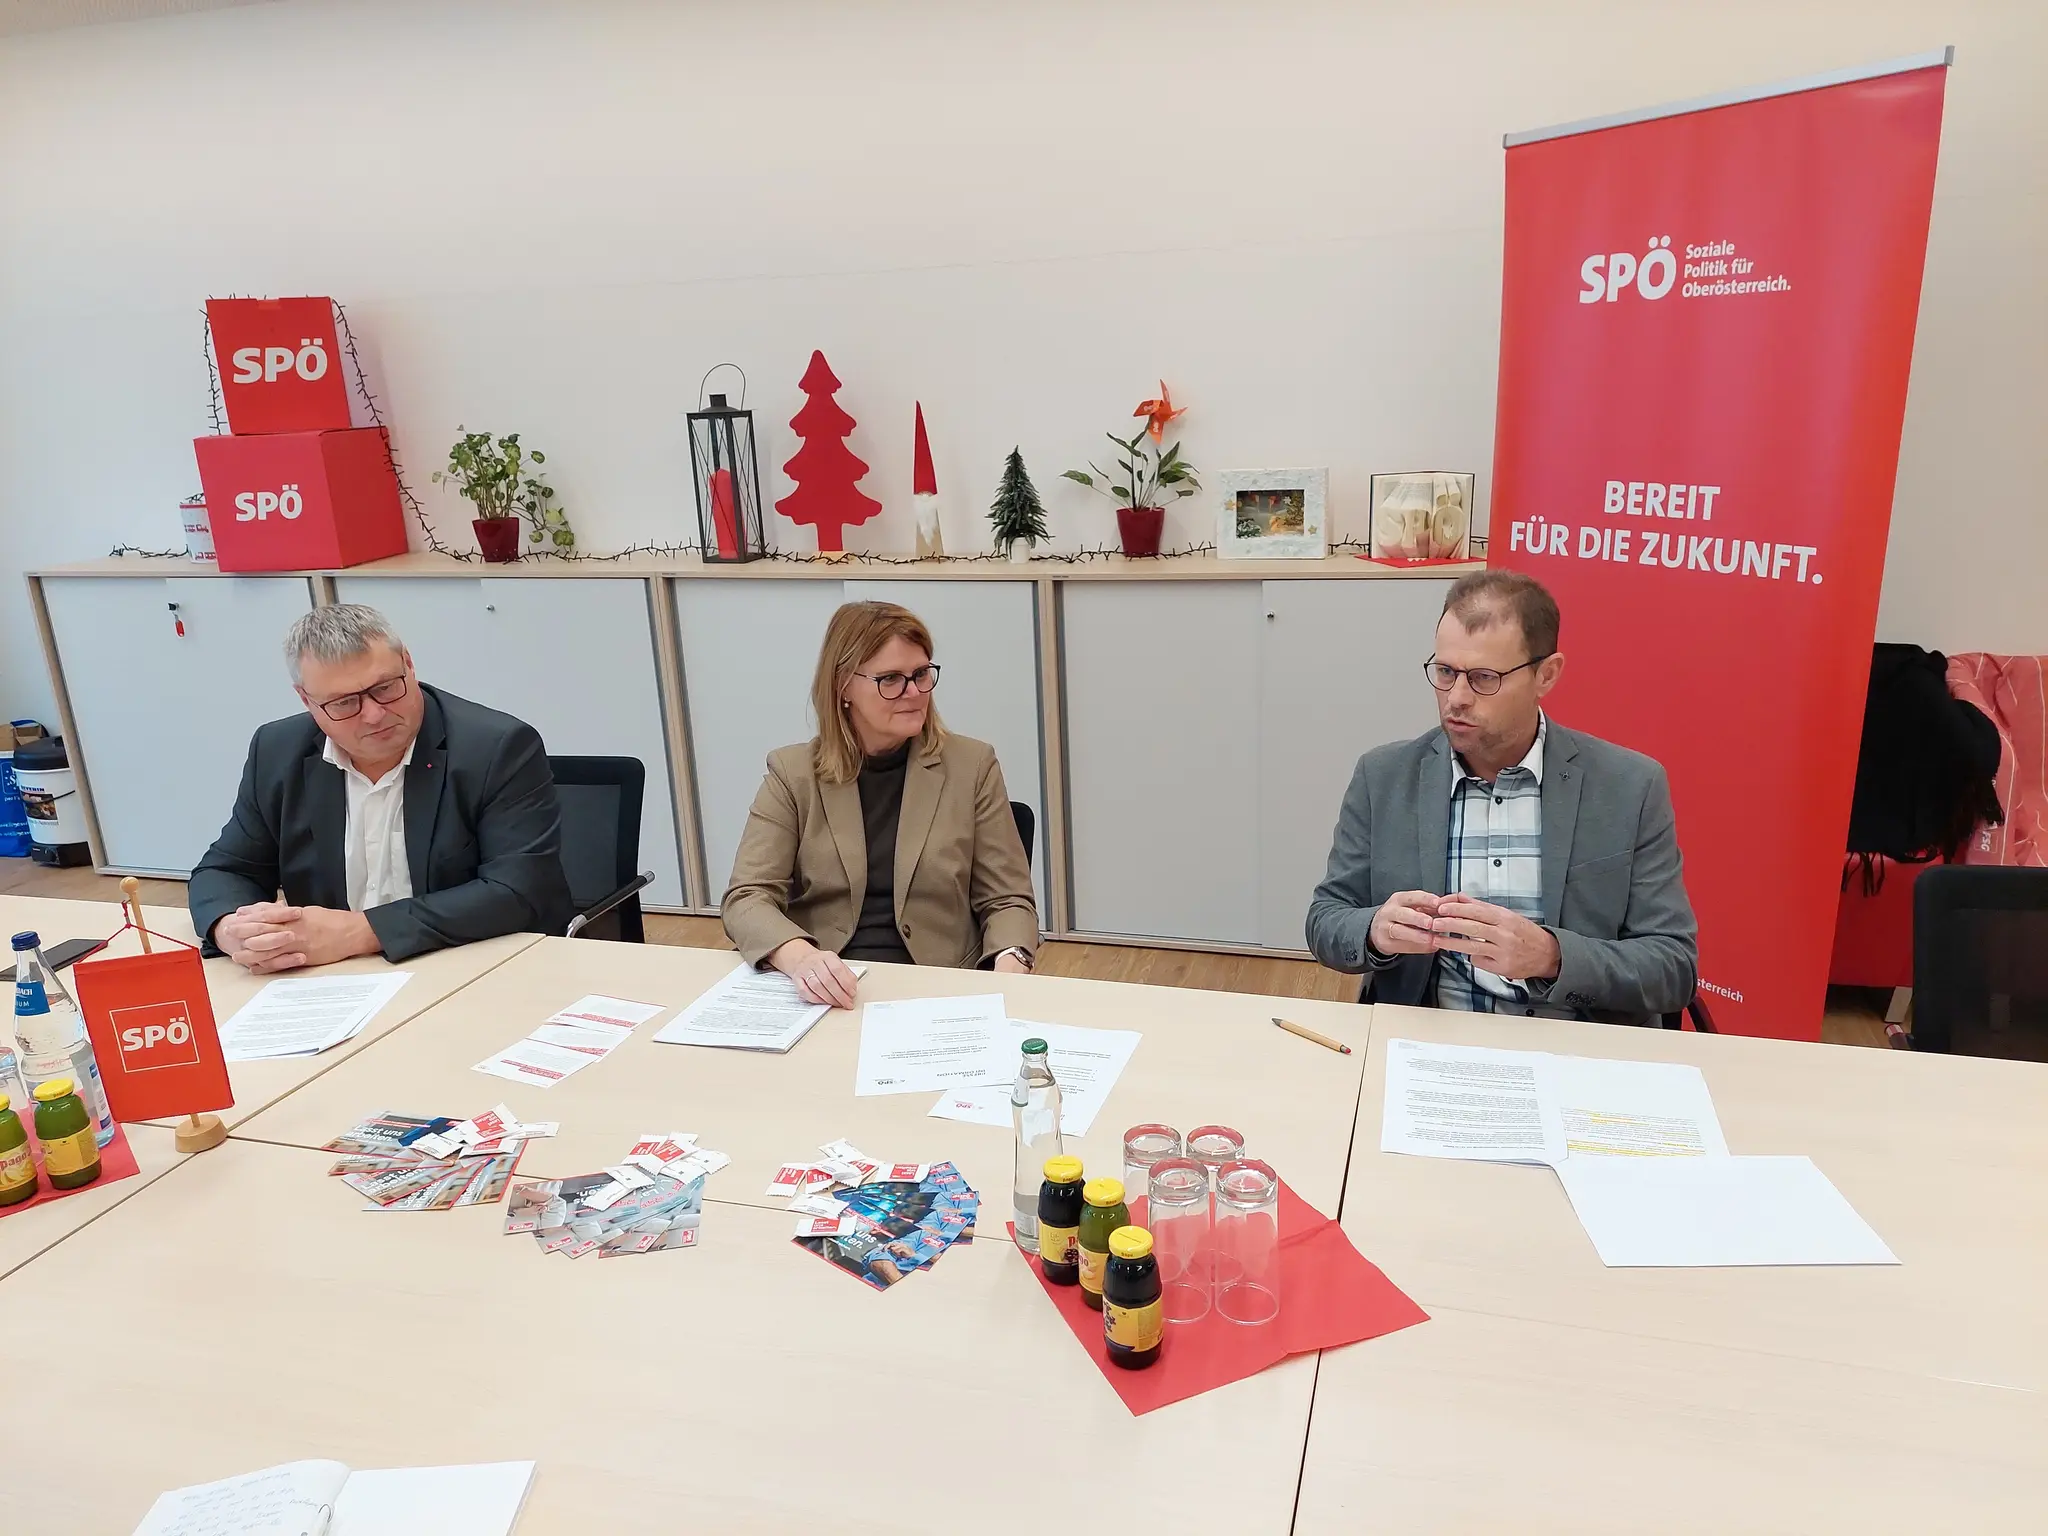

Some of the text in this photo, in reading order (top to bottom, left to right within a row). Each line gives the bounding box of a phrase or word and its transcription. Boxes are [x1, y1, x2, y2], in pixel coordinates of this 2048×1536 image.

[1684, 258, 1754, 279] Politik für
[1685, 240, 1735, 260] Soziale
[1579, 235, 1677, 304] SPÖ
[1681, 275, 1792, 298] Oberösterreich.
[232, 338, 328, 384] SPÖ
[235, 484, 303, 522] SPÖ
[1603, 480, 1721, 521] BEREIT
[1510, 514, 1824, 585] FÜR DIE ZUKUNFT.
[1697, 978, 1744, 1003] sterreich
[122, 1016, 190, 1052] SPÖ
